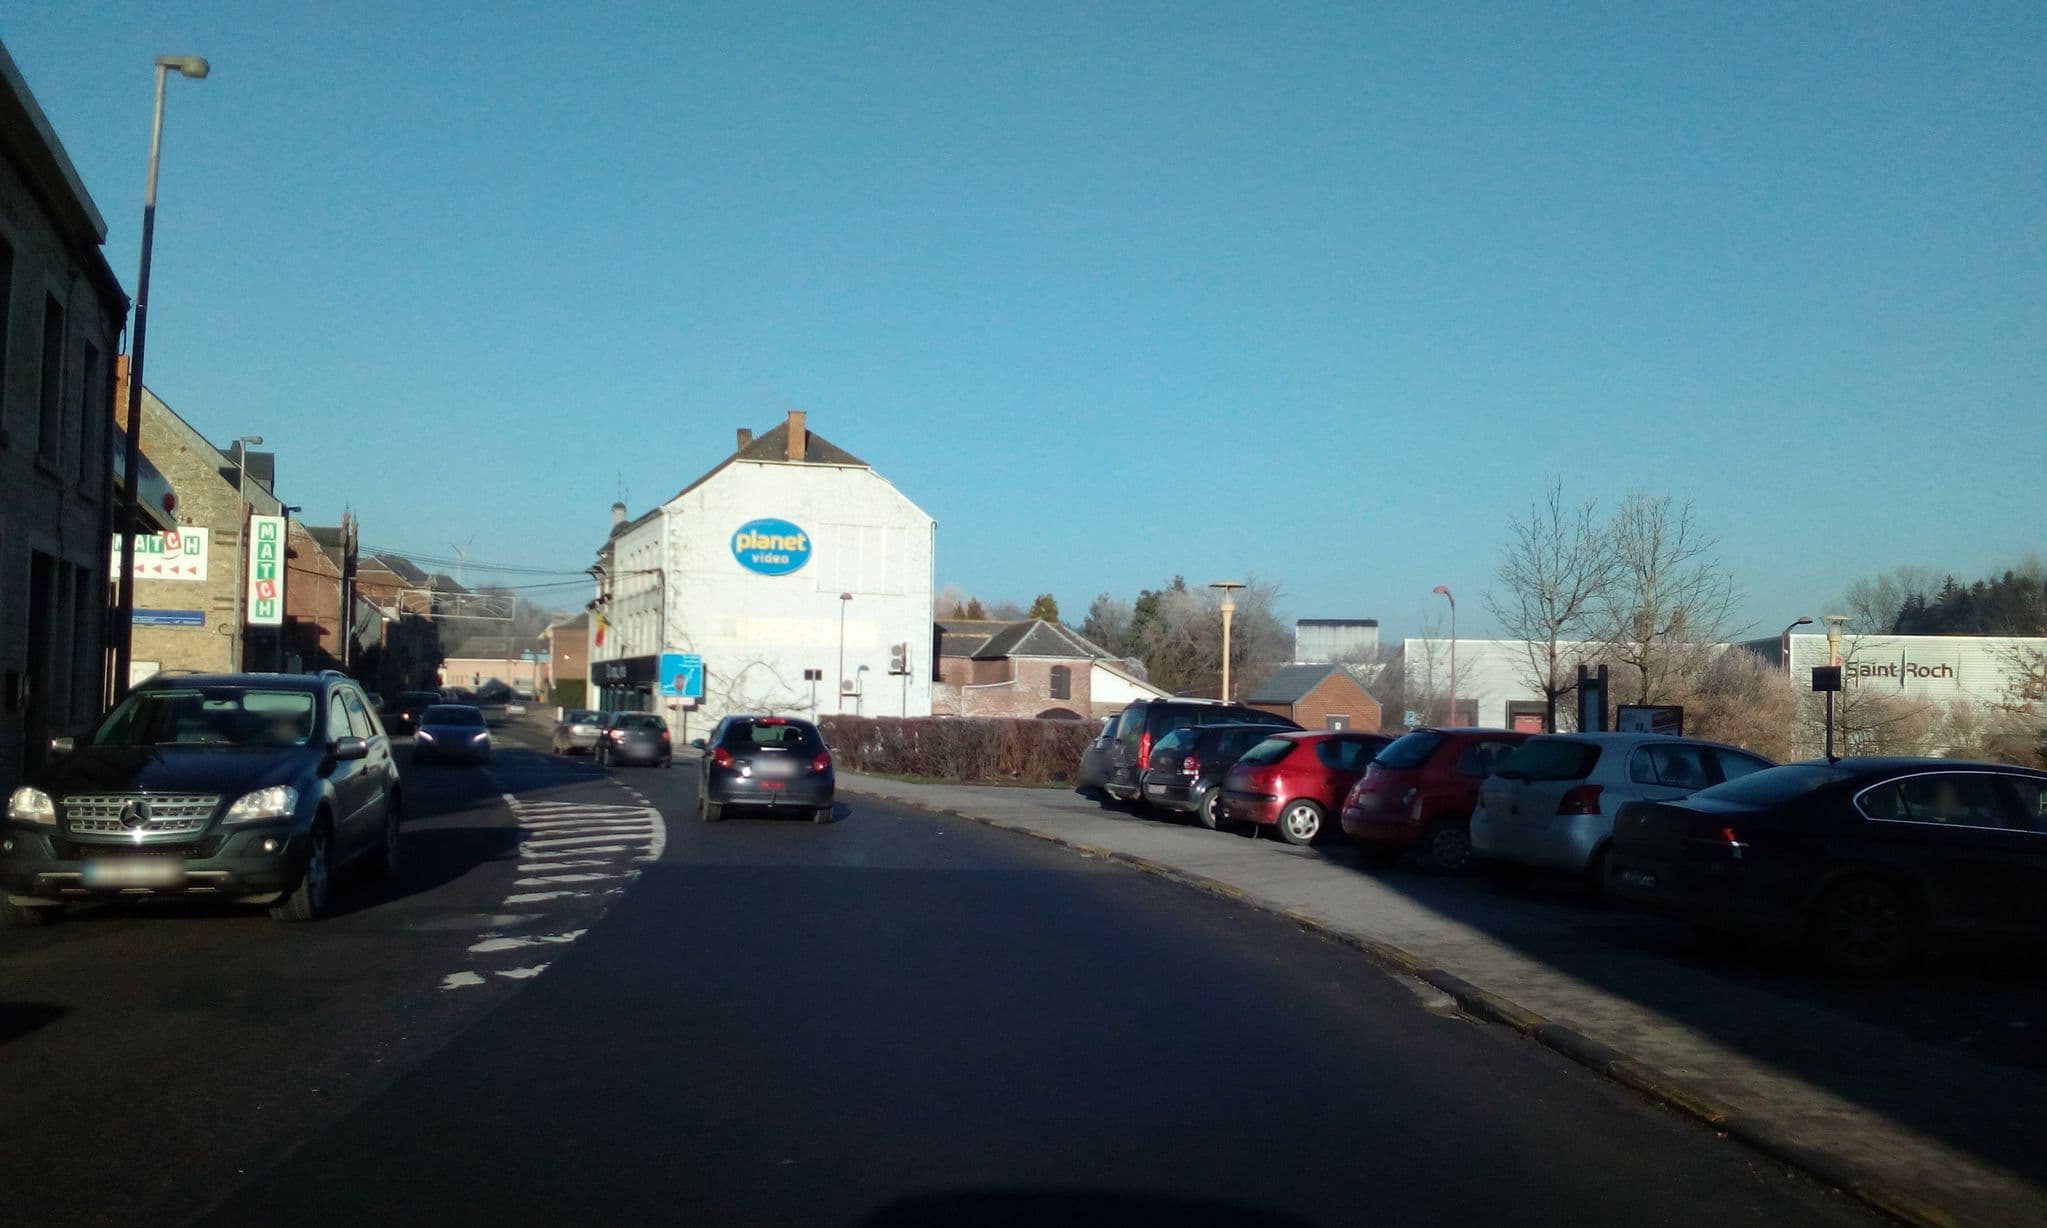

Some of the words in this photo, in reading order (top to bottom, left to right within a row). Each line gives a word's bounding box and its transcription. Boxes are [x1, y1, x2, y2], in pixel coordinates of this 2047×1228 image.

[736, 528, 807, 552] planet
[751, 551, 790, 564] video
[258, 523, 276, 617] MATCH
[1847, 662, 1897, 678] Saint
[1905, 662, 1953, 678] Roch
